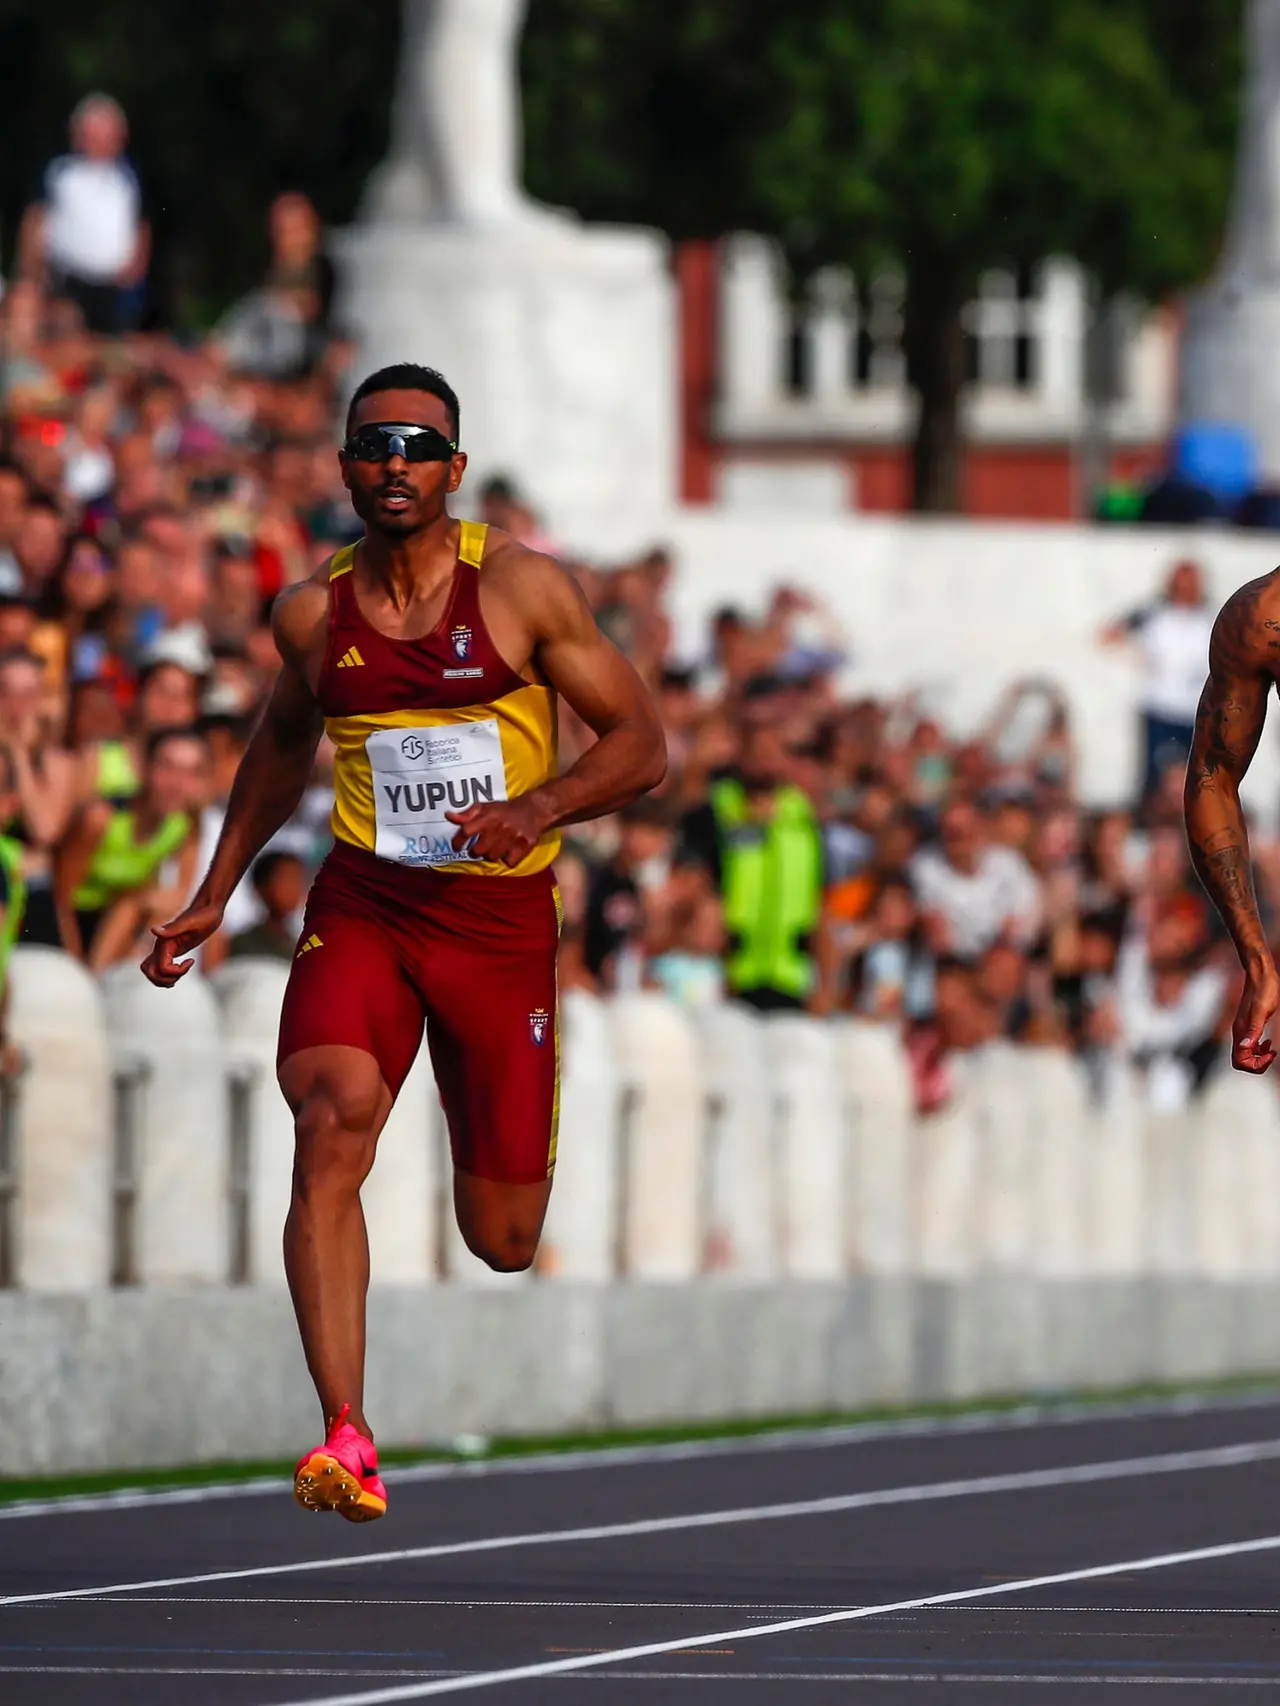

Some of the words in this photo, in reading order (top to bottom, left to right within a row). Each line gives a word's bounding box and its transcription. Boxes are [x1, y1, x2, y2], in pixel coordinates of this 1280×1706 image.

[401, 738, 424, 757] FIS
[384, 775, 494, 813] YUPUN
[403, 835, 452, 854] ROM
